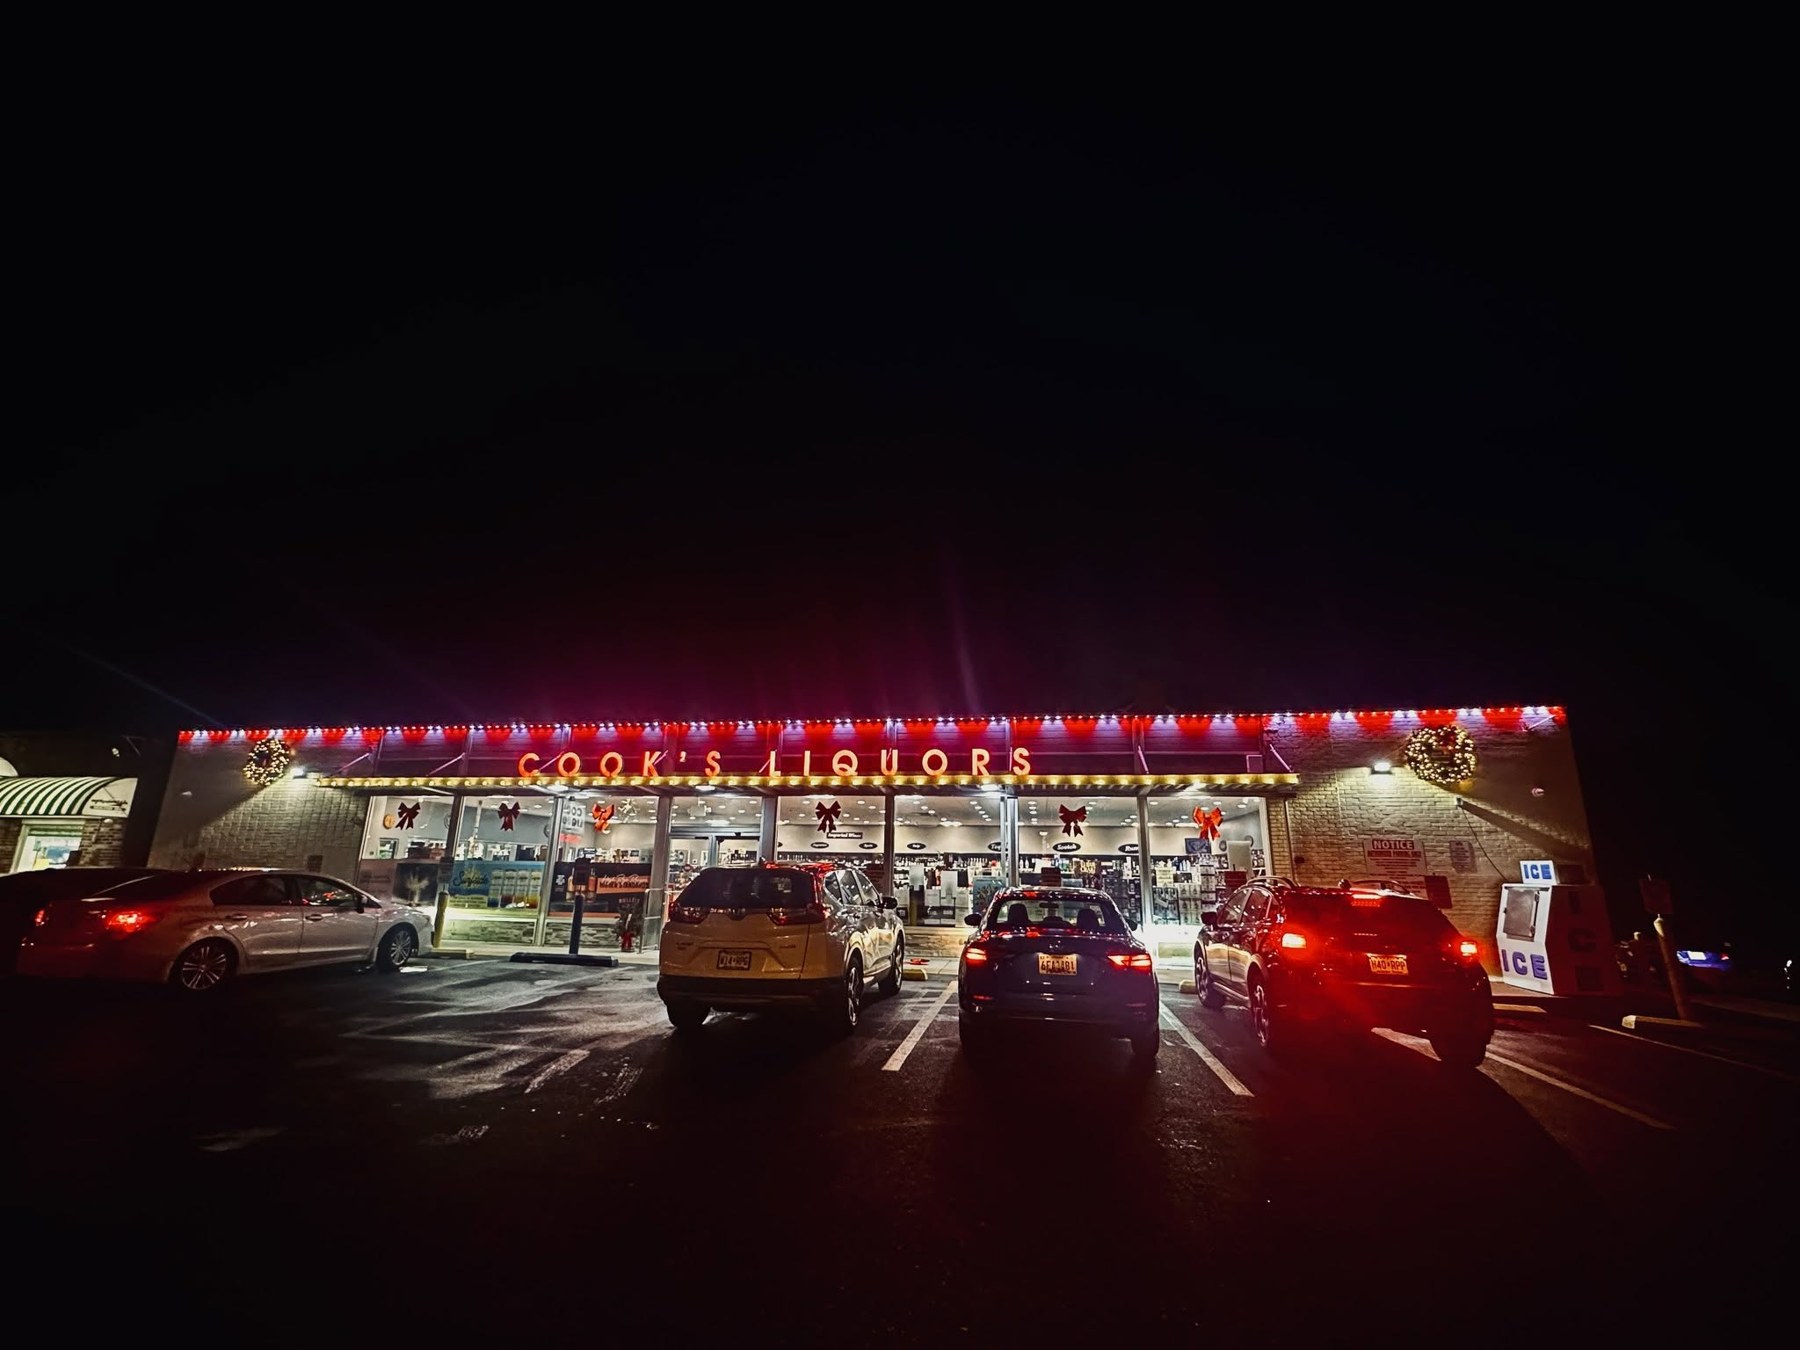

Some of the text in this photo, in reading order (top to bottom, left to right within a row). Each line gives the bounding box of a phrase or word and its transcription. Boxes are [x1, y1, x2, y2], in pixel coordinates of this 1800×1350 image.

[518, 748, 1031, 777] COOK'S LIQUORS
[1373, 840, 1414, 850] NOTICE
[1523, 864, 1552, 879] ICE
[1501, 949, 1548, 980] ICE
